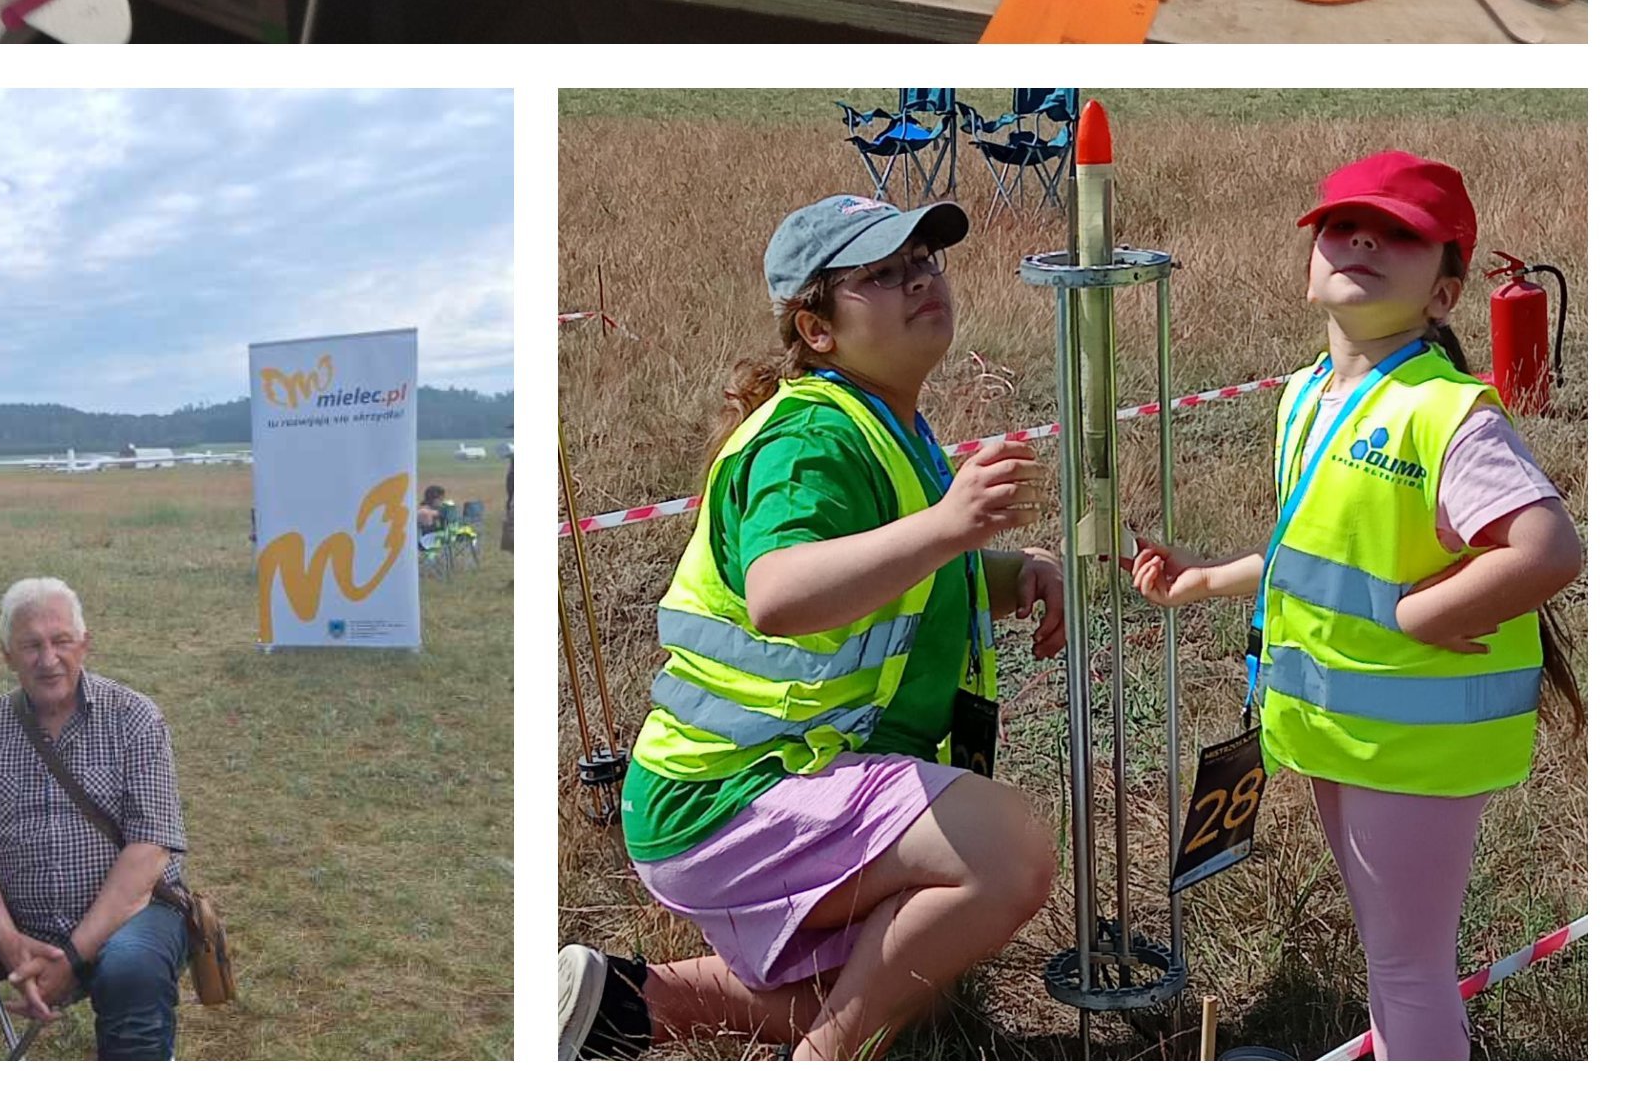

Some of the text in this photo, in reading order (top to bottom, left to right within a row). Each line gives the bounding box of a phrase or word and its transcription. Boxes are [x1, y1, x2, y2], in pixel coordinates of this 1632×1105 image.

[316, 384, 408, 408] mielec.pl
[1366, 451, 1427, 479] OLIMP
[1184, 767, 1265, 854] 28
